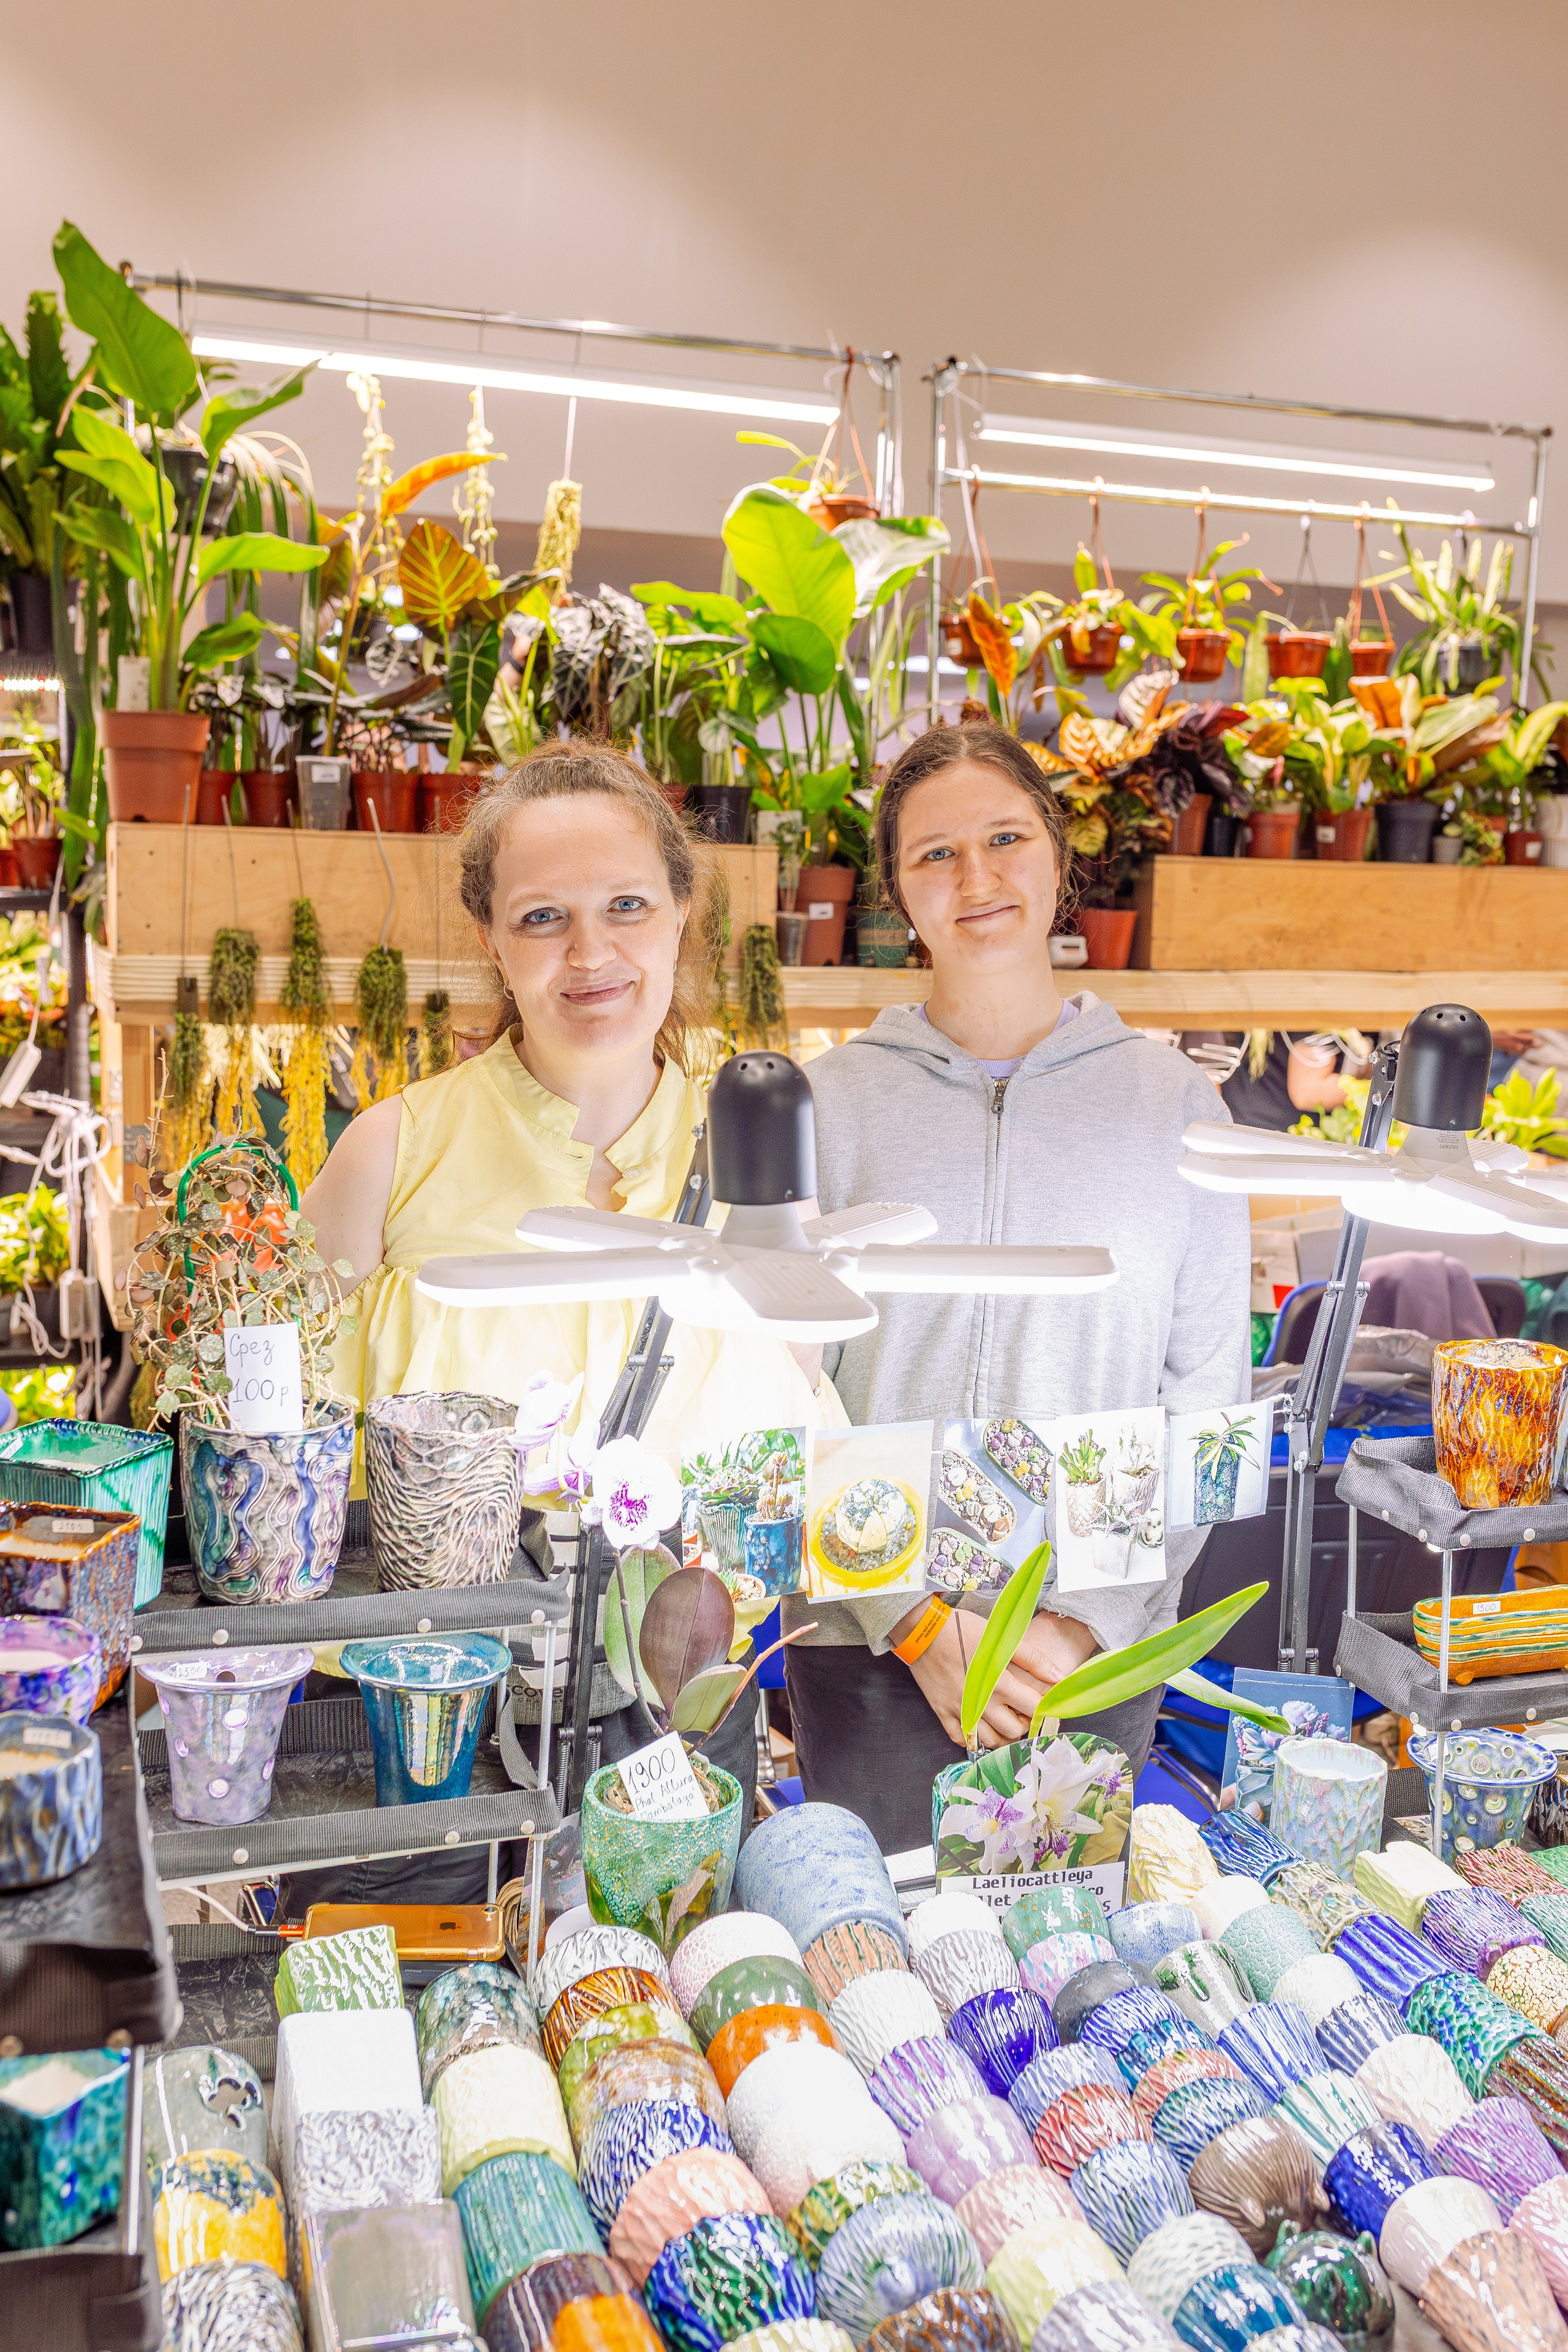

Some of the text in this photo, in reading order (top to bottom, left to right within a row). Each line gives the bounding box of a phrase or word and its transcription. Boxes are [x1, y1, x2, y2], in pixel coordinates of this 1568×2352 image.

[230, 1333, 274, 1368] Срез
[232, 1379, 274, 1403] 100
[1478, 1604, 1496, 1612] 1500
[628, 1747, 676, 1795] 1900
[973, 1869, 1093, 1890] Laeliocattleya
